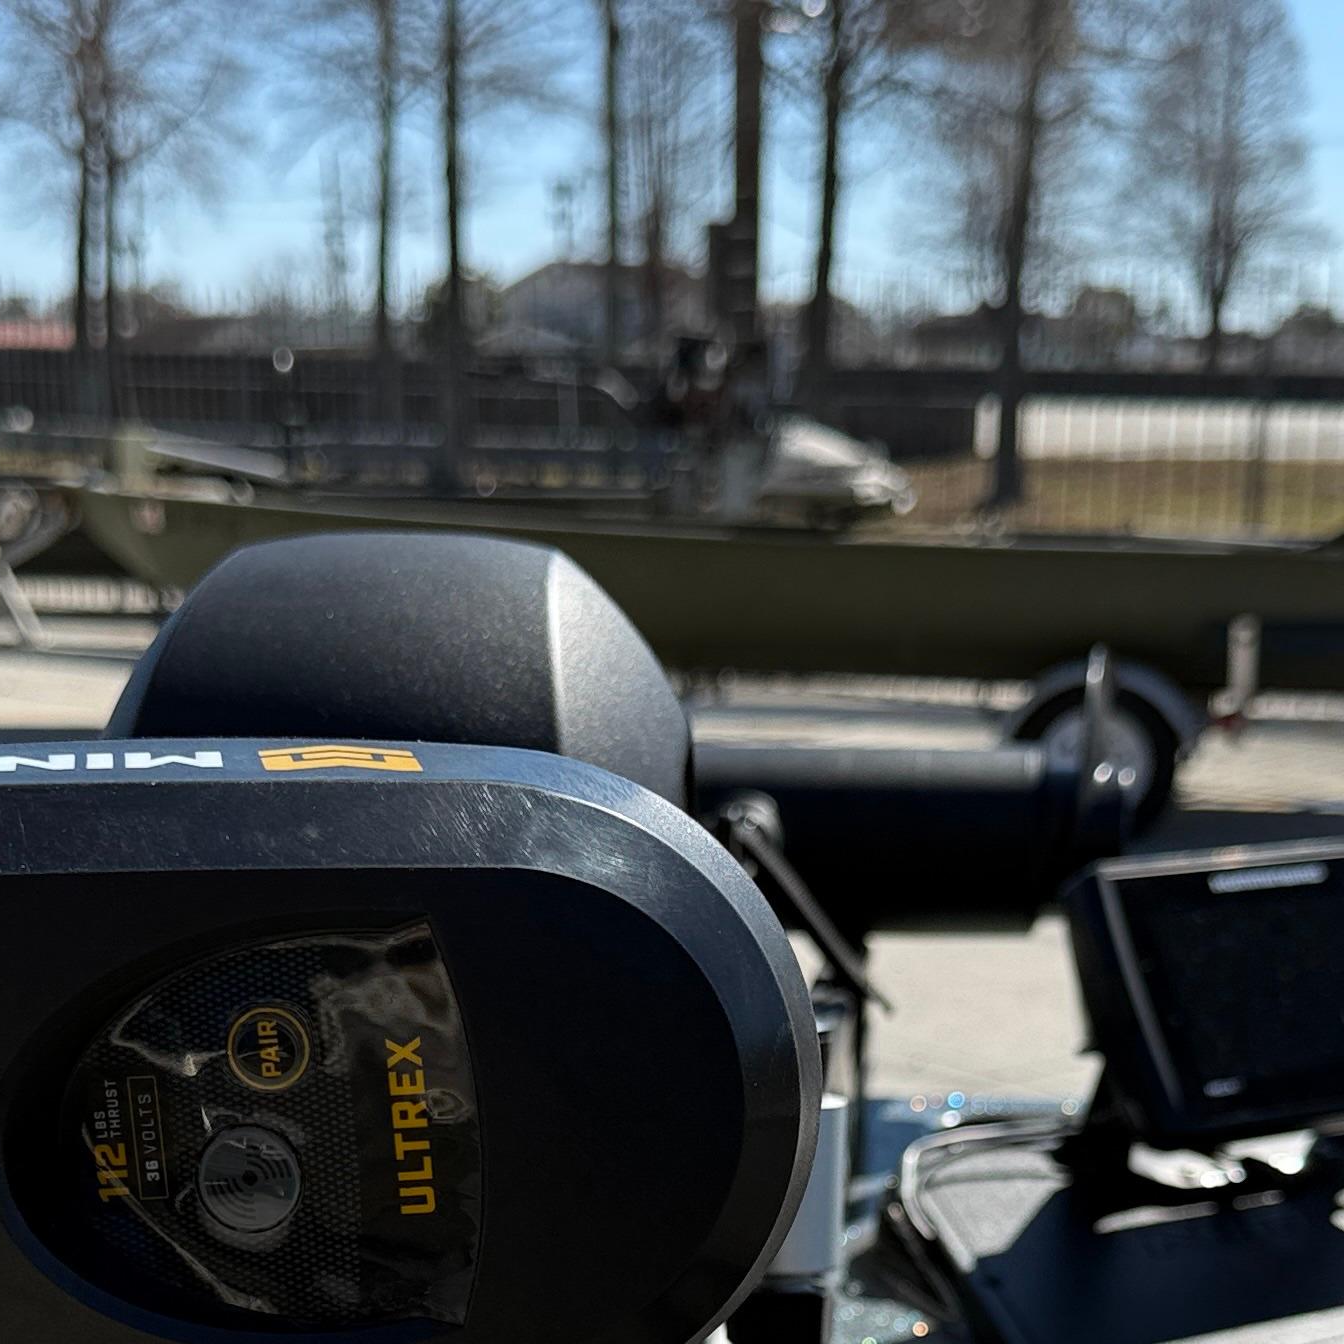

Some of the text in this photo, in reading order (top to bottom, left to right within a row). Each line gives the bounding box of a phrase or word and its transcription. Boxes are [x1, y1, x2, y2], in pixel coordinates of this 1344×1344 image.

[260, 1020, 282, 1077] PAIR
[104, 1080, 122, 1139] THRUST
[137, 1093, 161, 1182] 36 VOLTS
[385, 1037, 436, 1215] ULTREX
[94, 1110, 130, 1202] 112 LBS
